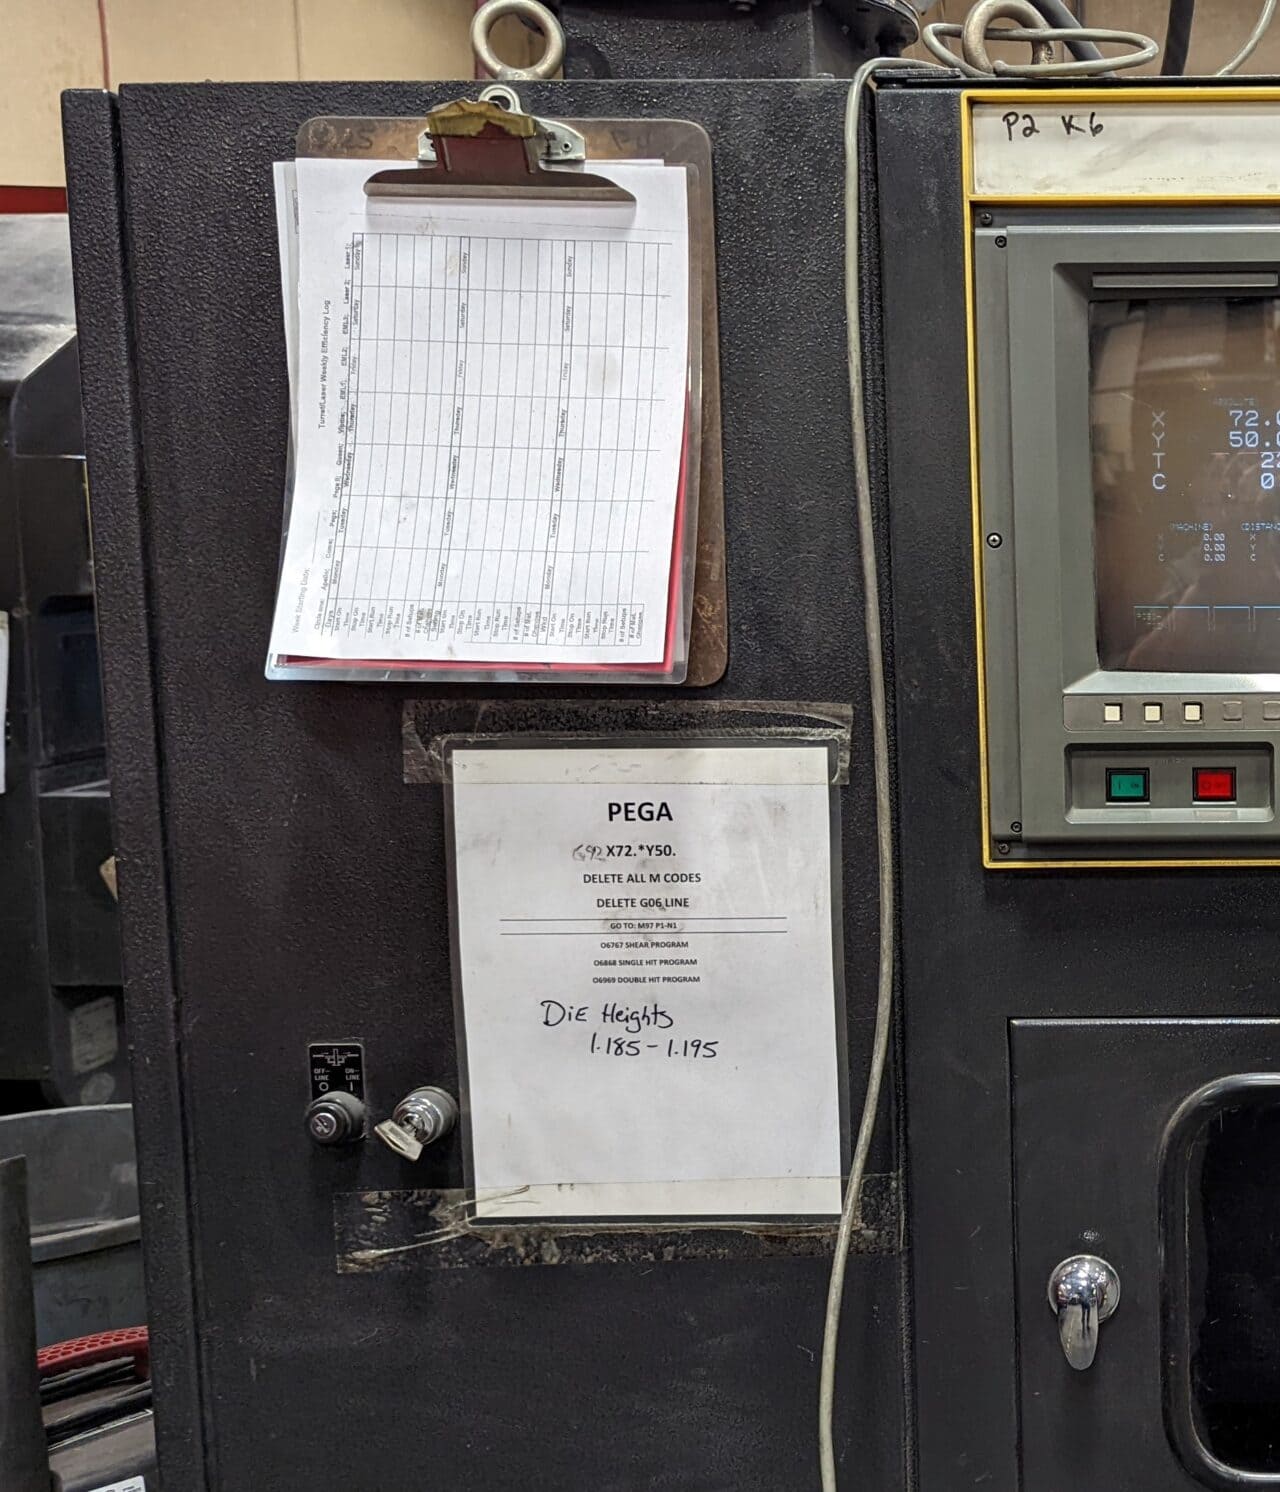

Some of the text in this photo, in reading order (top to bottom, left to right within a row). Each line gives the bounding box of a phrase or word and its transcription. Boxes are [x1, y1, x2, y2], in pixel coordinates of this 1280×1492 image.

[1002, 112, 1104, 141] P2 K6
[1152, 411, 1166, 427] X
[1152, 431, 1166, 448] Y
[1152, 453, 1166, 469] T
[1152, 473, 1167, 490] C
[608, 801, 673, 822] PEGA
[583, 872, 701, 884] DELETE ALL M CODES
[596, 898, 689, 908] DELETE G06 LINE
[610, 922, 622, 930] GO
[625, 941, 648, 949] SHEAR
[617, 976, 646, 984] DOUBLE
[602, 1002, 674, 1033] Heights
[591, 1032, 719, 1058] 1.185 1.195
